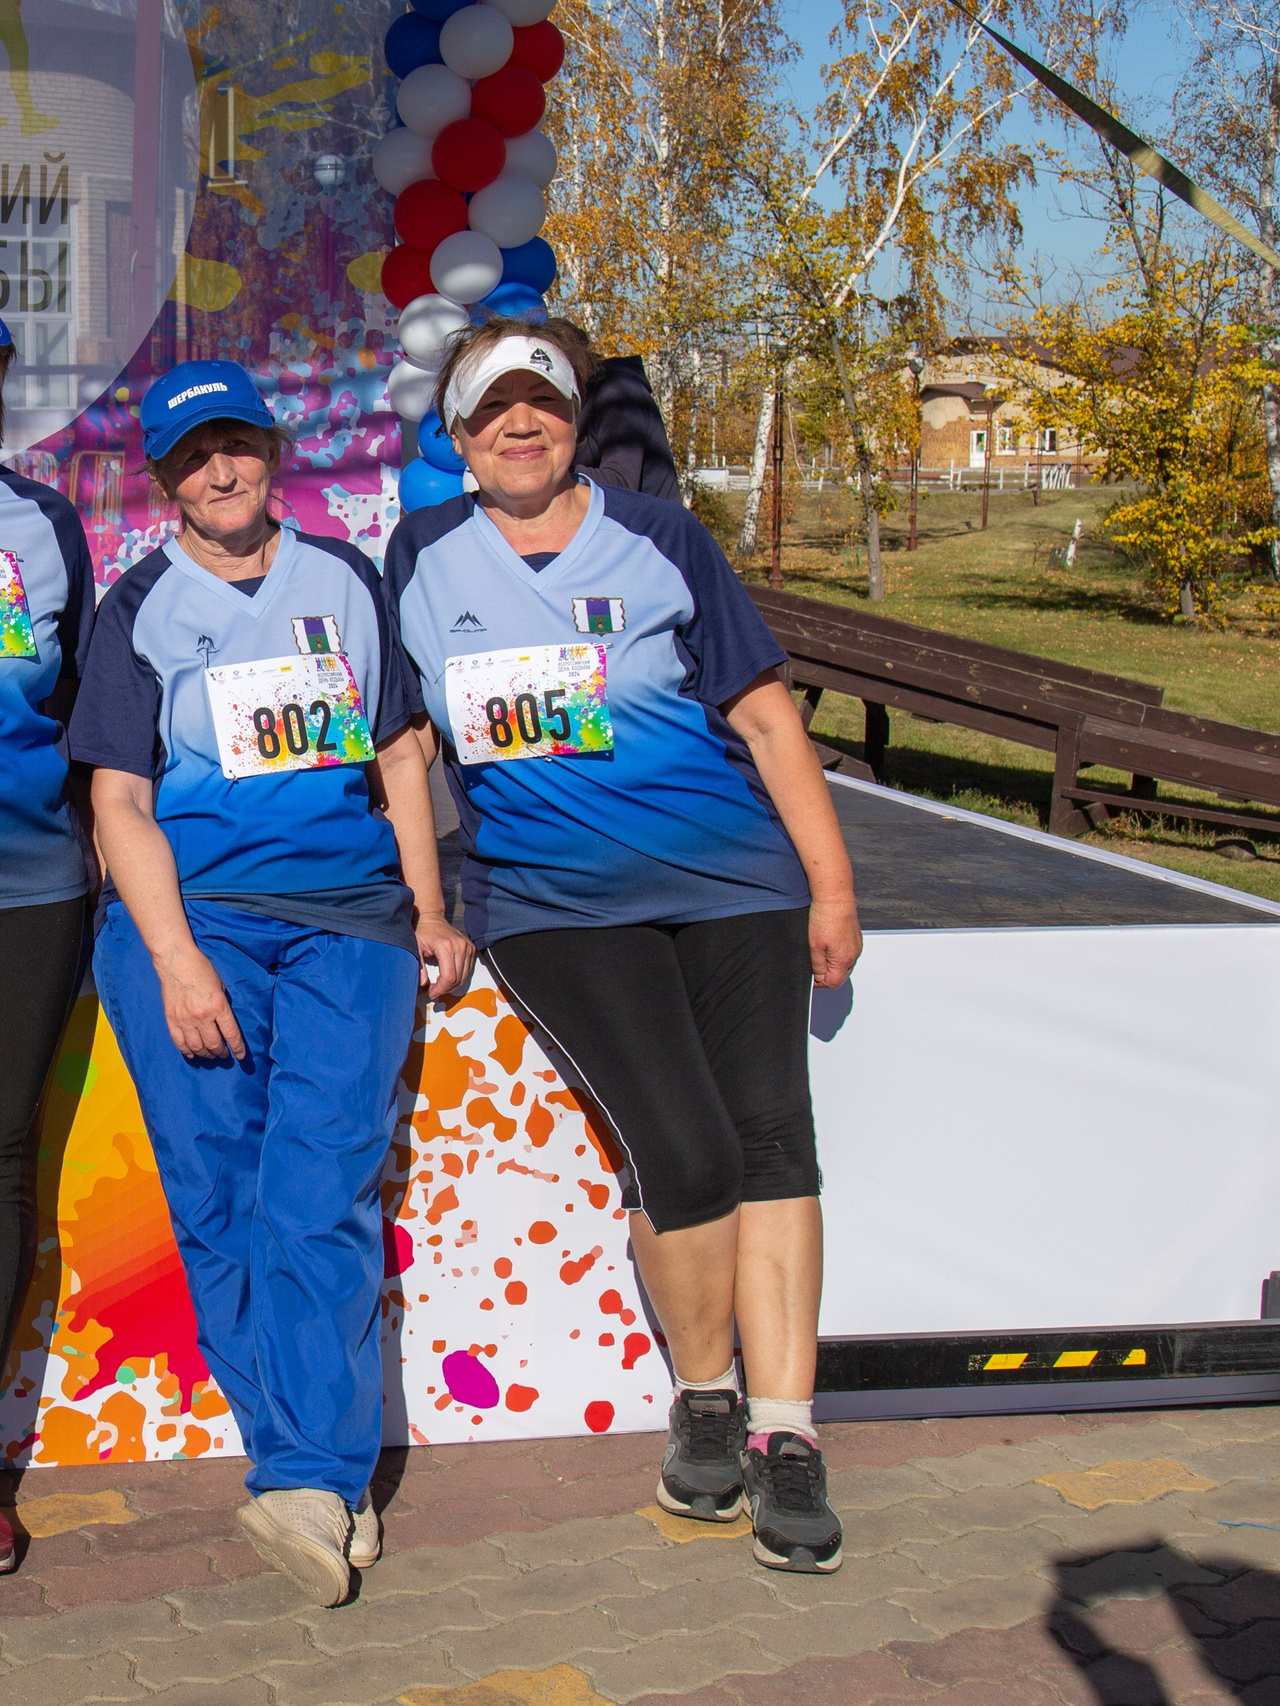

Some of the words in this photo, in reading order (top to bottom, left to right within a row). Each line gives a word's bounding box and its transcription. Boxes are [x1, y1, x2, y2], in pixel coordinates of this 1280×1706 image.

[167, 382, 228, 410] ШЕРБАКУЛЬ
[253, 700, 338, 760] 802
[486, 688, 572, 748] 805
